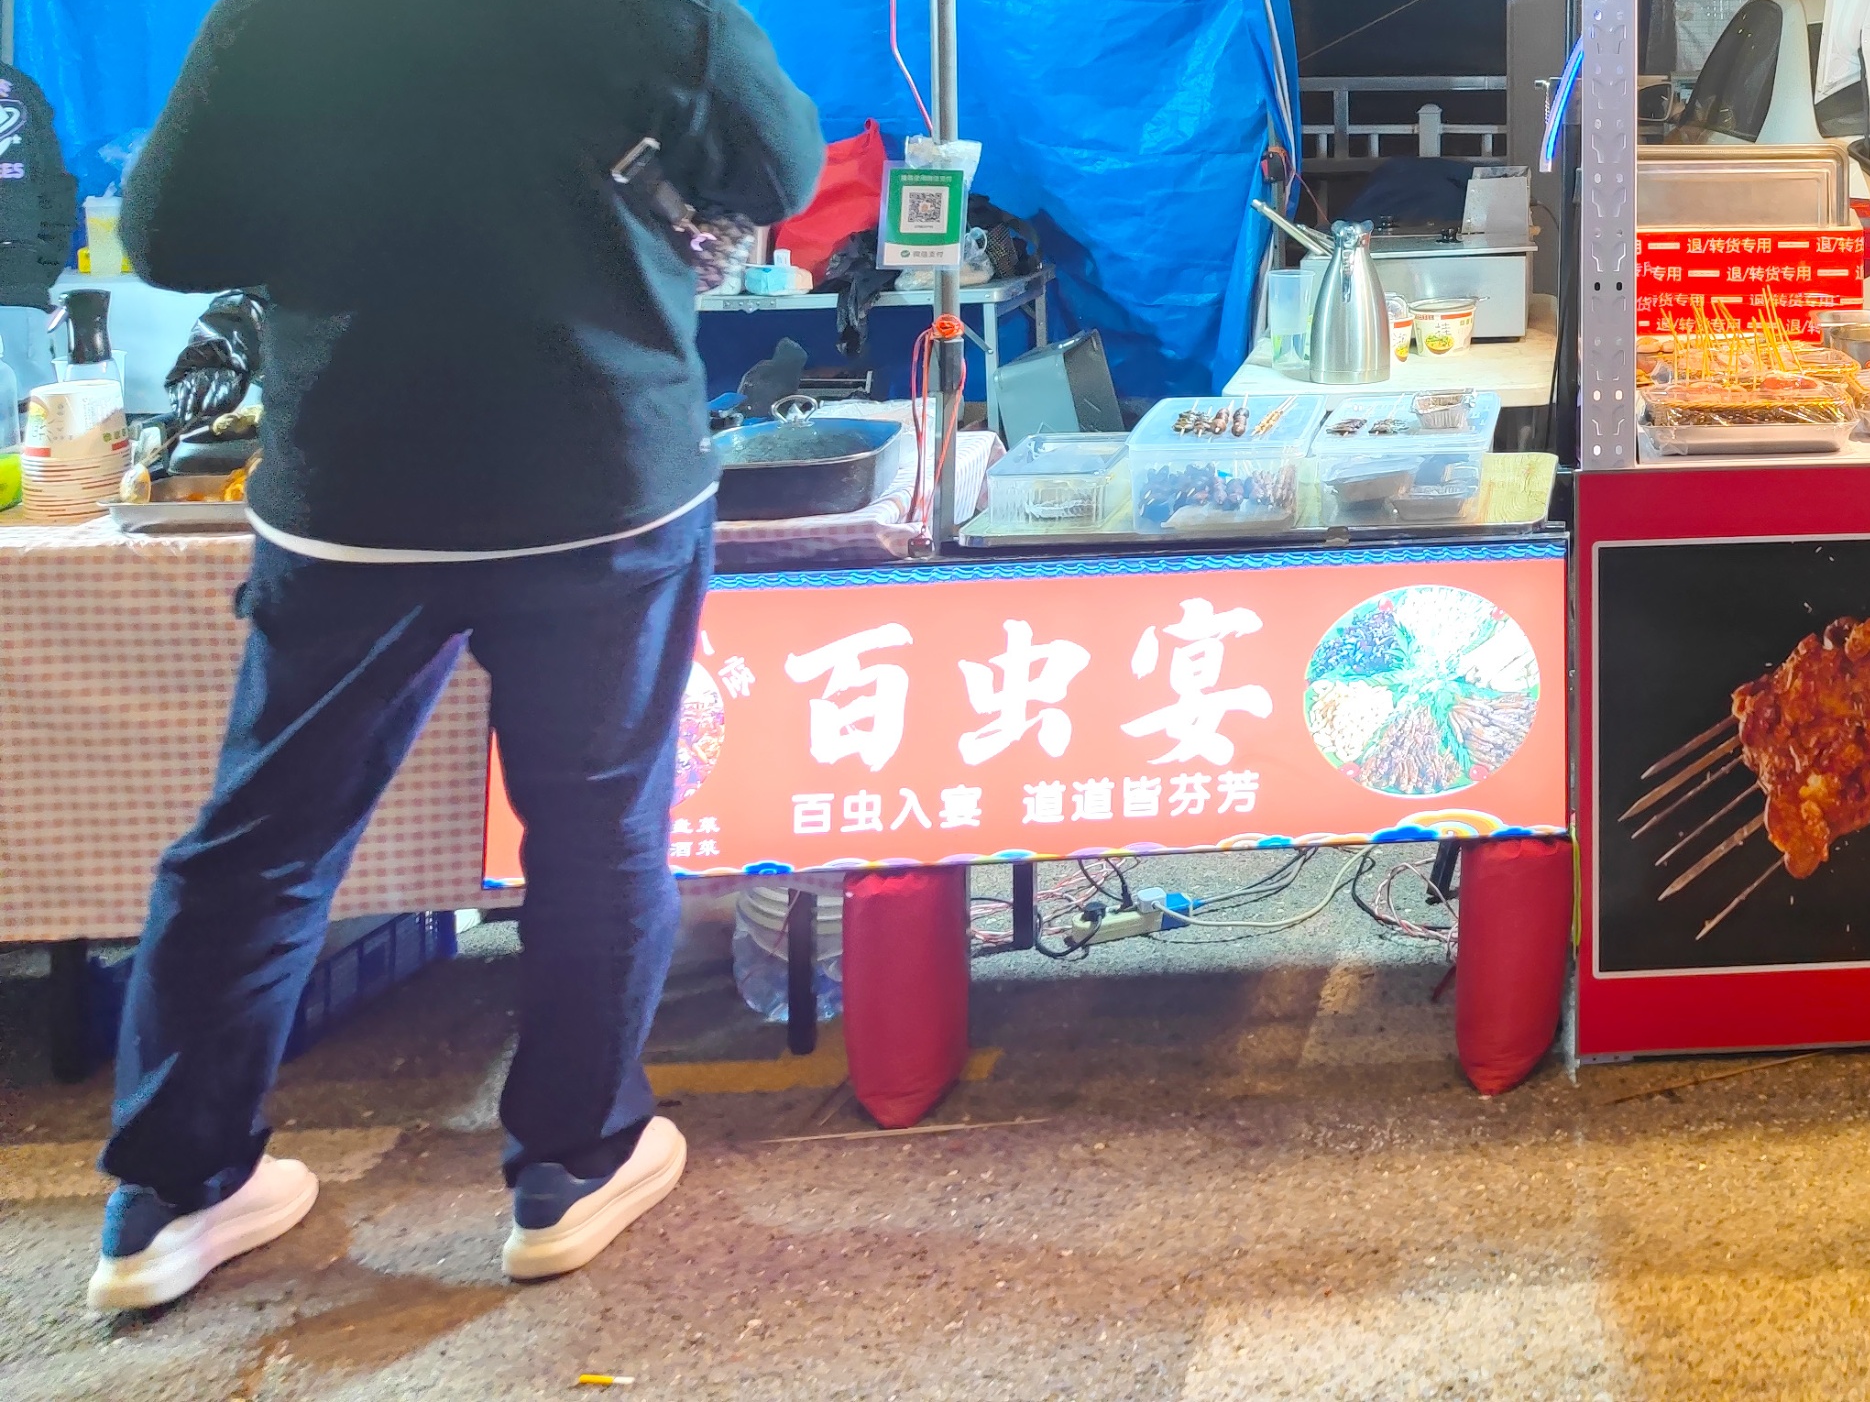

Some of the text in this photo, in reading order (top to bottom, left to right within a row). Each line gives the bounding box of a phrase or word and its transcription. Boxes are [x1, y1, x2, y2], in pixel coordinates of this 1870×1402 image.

[1686, 237, 1772, 254] 退/转货专用
[1726, 265, 1812, 282] 退/转货专用
[785, 597, 1273, 773] 百虫宴
[791, 769, 1261, 837] 百虫入宴 道道皆芬芳
